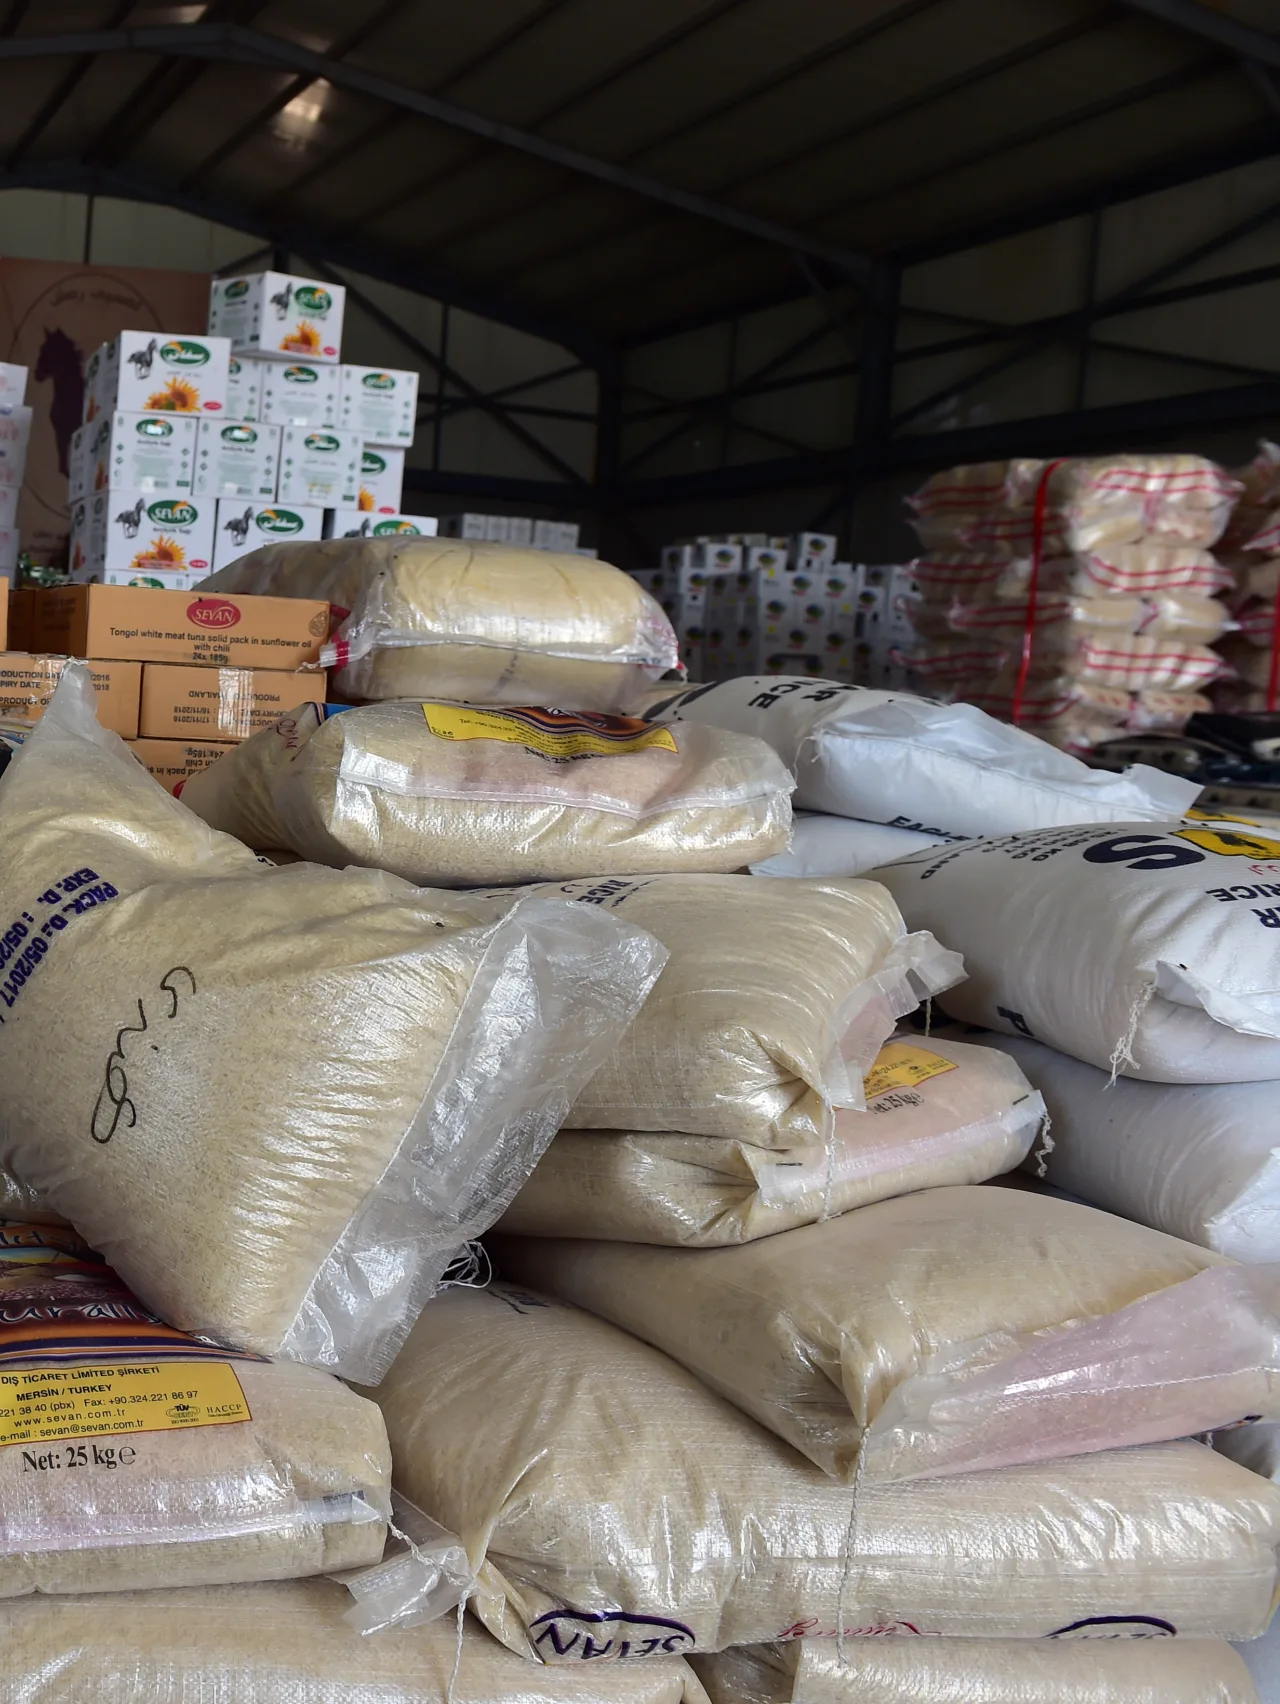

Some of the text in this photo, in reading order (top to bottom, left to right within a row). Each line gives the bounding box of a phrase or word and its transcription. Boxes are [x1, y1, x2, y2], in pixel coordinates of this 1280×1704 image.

[195, 608, 234, 622] SEVAN
[110, 627, 312, 648] Tongol white meat tuna solid pack in sunflower oil
[194, 643, 211, 651] with
[192, 652, 207, 661] 24x
[22, 681, 41, 689] DATE
[166, 766, 186, 774] pack
[56, 868, 100, 892] EXP.
[37, 889, 62, 904] D.
[62, 882, 119, 914] PACK.
[0, 937, 49, 1008] 05/2017
[1, 1376, 20, 1387] DIŞ
[22, 1371, 69, 1385] TİCARET
[71, 1369, 115, 1380] LİMİTED
[117, 1366, 161, 1379] ŞİRKETİ
[16, 1389, 60, 1402] MERSİN
[67, 1384, 113, 1396] TURKEY
[19, 1405, 33, 1416] 38
[34, 1403, 48, 1414] 40
[50, 1400, 76, 1414] (pbx)
[84, 1396, 106, 1409] Fax:
[108, 1393, 169, 1406] +90.324.221
[171, 1391, 185, 1401] 86
[186, 1390, 199, 1400] 97
[206, 1404, 242, 1413] HACCP
[0, 1418, 144, 1442] e-mail sevan@sevan.com.tr
[22, 1450, 62, 1473] Net:
[66, 1447, 89, 1467] 25
